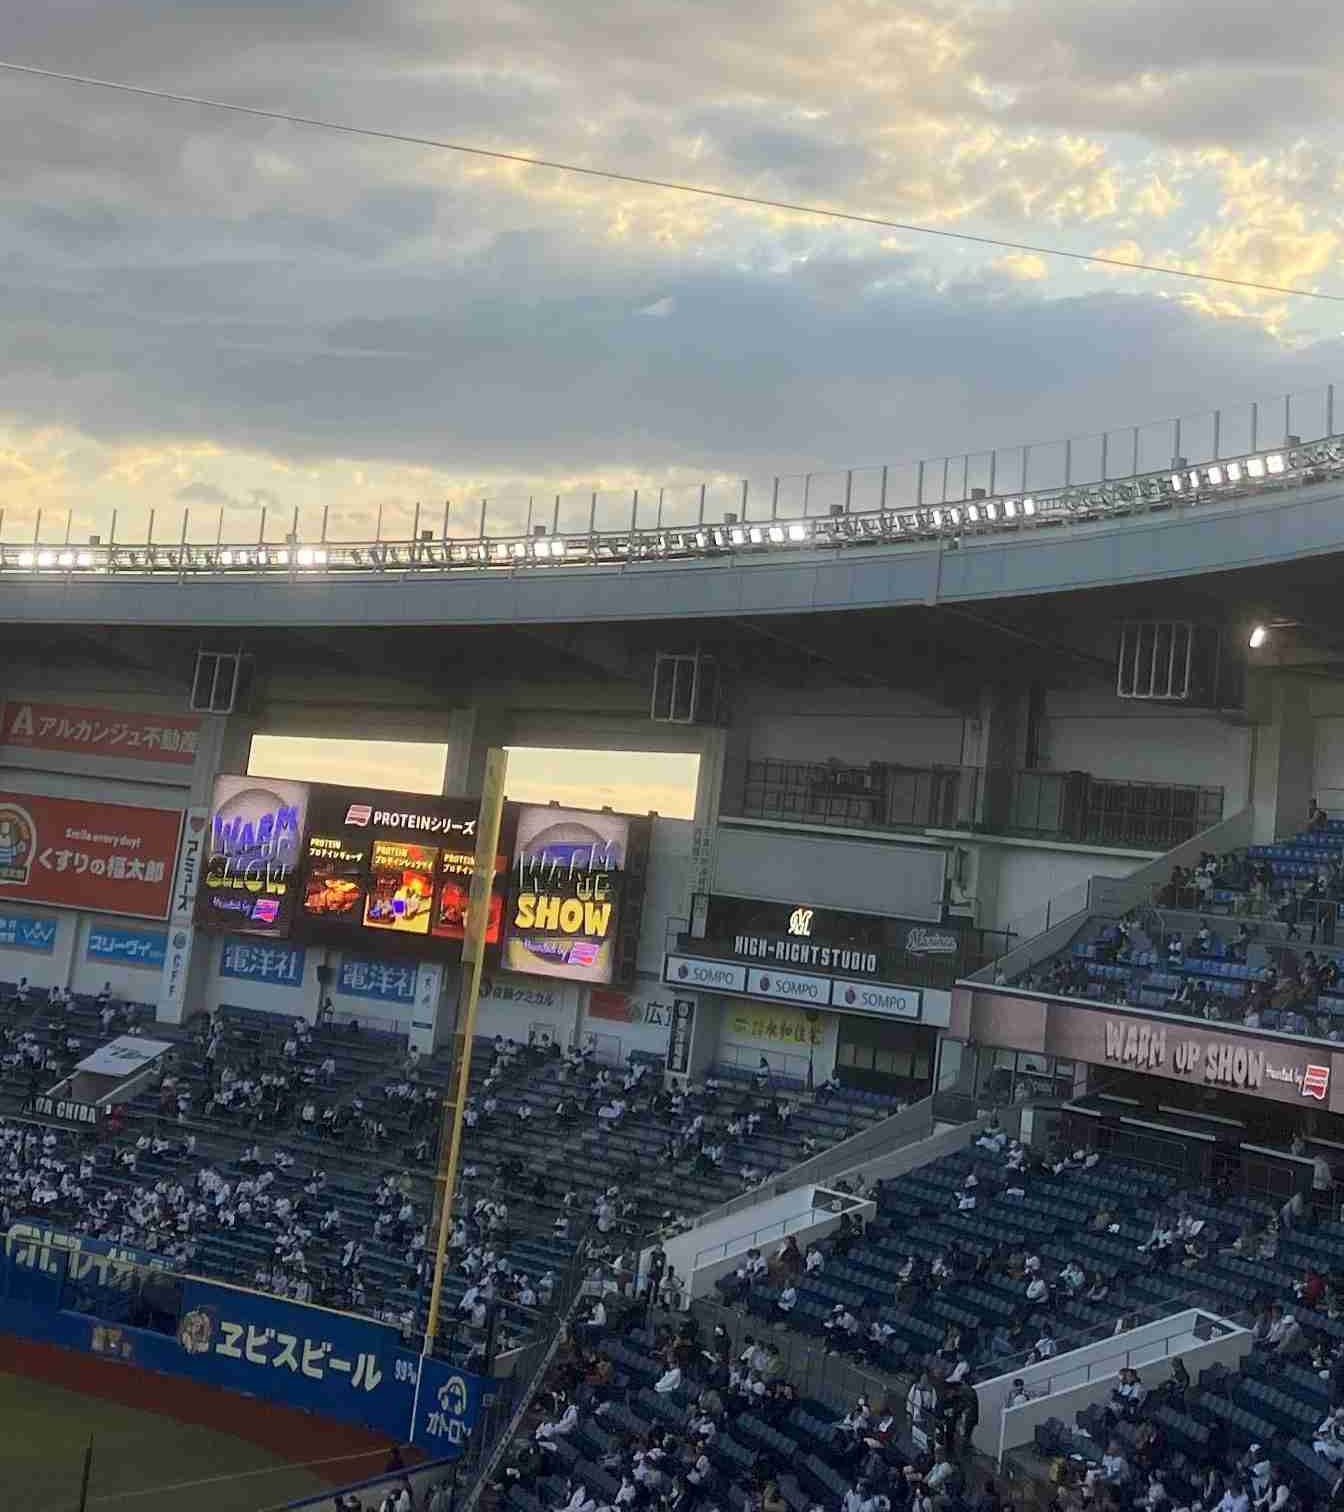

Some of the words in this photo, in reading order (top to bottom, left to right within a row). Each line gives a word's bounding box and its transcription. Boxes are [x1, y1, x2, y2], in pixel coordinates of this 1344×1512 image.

[373, 810, 478, 836] PROTEINシリーズ
[38, 847, 166, 883] くすりの福太郎
[514, 891, 612, 937] SHOW
[223, 944, 301, 980] 電洋社
[343, 961, 416, 998] 電洋社
[692, 967, 734, 984] SOMPO
[775, 980, 818, 999] SOMPO
[861, 992, 906, 1011] SOMPO
[1105, 1020, 1167, 1067] WARM
[1174, 1039, 1201, 1074] UP
[1205, 1043, 1265, 1090] SHOW
